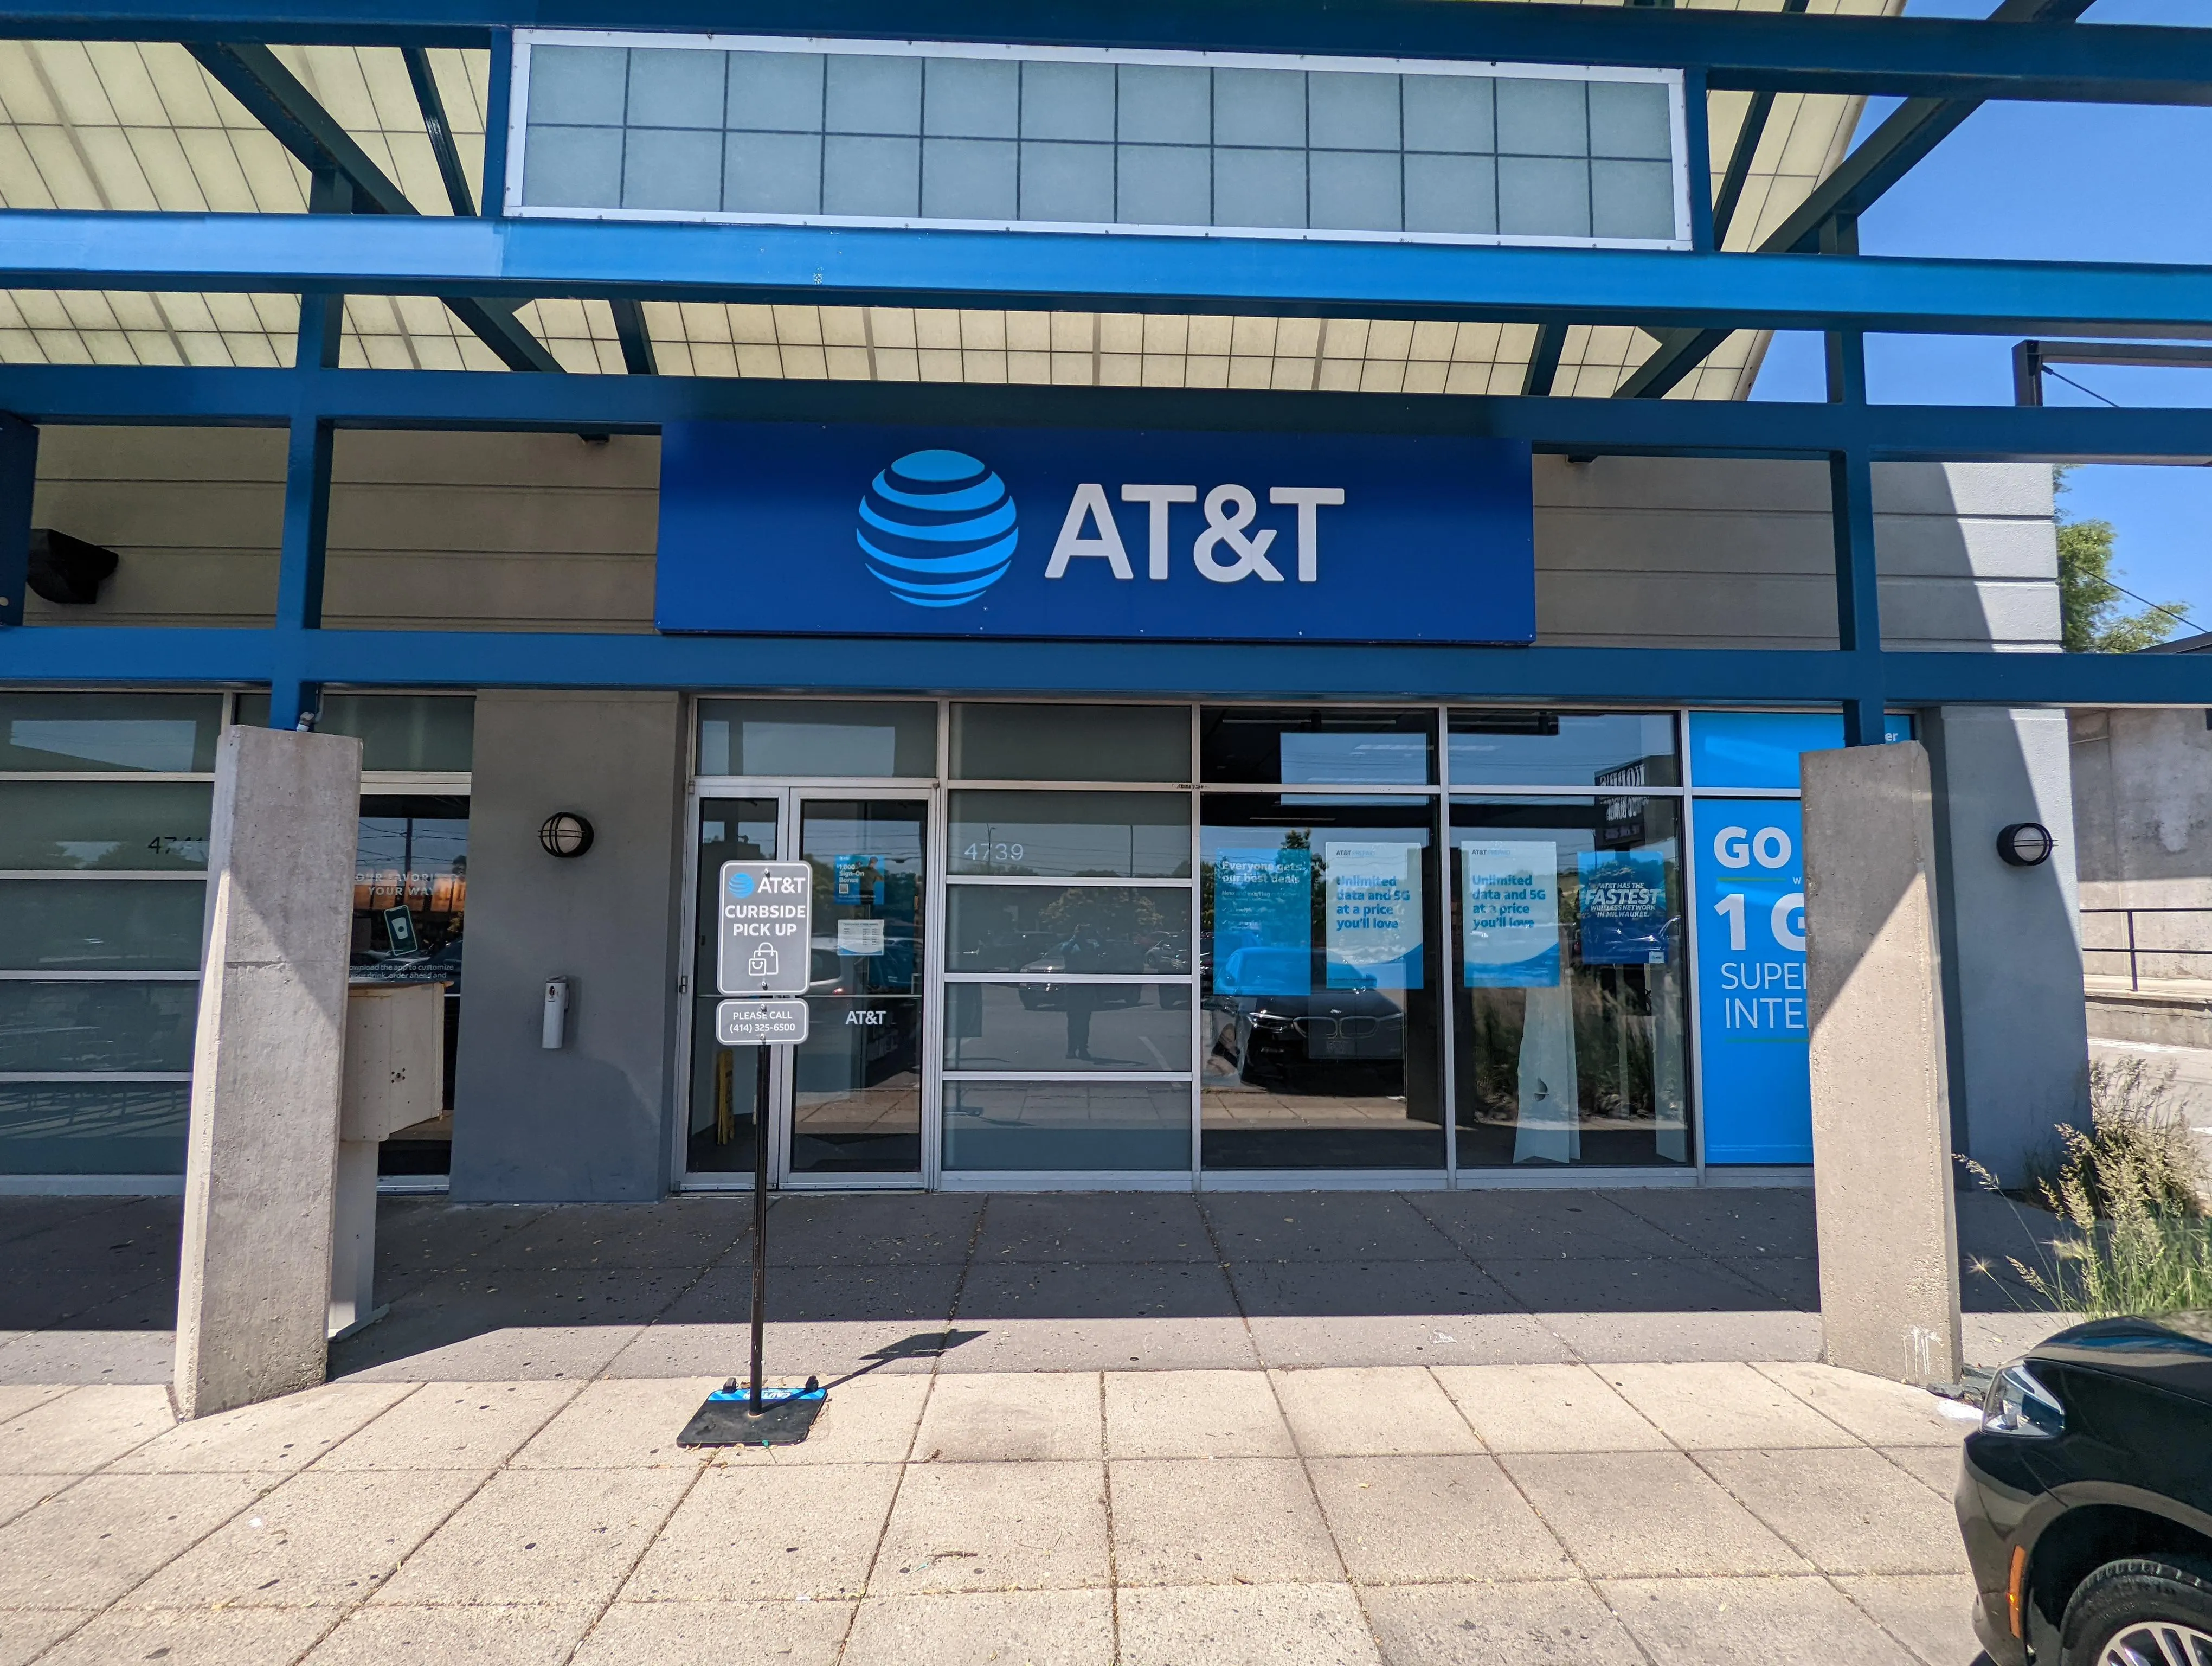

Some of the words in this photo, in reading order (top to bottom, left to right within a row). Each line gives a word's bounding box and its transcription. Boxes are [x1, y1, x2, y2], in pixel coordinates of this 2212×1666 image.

[1044, 483, 1345, 582] AT&T
[1885, 733, 1898, 741] er
[964, 843, 1023, 860] 4739
[1714, 826, 1791, 868] GO
[1222, 861, 1274, 872] Everyone
[1276, 863, 1302, 873] gets
[355, 873, 383, 882] OUR
[1222, 875, 1241, 883] our
[1244, 873, 1268, 883] best
[1271, 873, 1300, 883] deals
[1336, 875, 1397, 886] Unlimited
[1472, 875, 1532, 885] Unlimited
[368, 887, 402, 895] YOUR
[757, 877, 806, 894] AT&T
[1336, 889, 1365, 900] data
[1368, 889, 1391, 900] and
[1394, 890, 1410, 900] 5G
[1472, 888, 1500, 900] data
[1504, 888, 1527, 900] and
[1529, 889, 1546, 900] 5G
[1585, 889, 1662, 905] FASTEST
[725, 905, 806, 918] CURBSIDE
[1336, 905, 1349, 914] at
[1353, 906, 1360, 914] a
[1363, 904, 1393, 917] price
[1473, 904, 1486, 914] at
[1489, 905, 1496, 914] a
[1500, 902, 1529, 916] price
[1336, 917, 1369, 931] you'll
[1373, 917, 1398, 928] love
[1473, 917, 1506, 930] you'll
[1509, 917, 1534, 927] love
[1713, 894, 1746, 950] 1
[733, 923, 771, 936] PICK
[775, 923, 797, 936] UP
[733, 1011, 767, 1020] PLEASE
[769, 1011, 792, 1019] CALL
[845, 1010, 886, 1024] AT&T
[1725, 998, 1809, 1028] INTE
[730, 1024, 753, 1033] (414)
[754, 1023, 795, 1031] 325-6500
